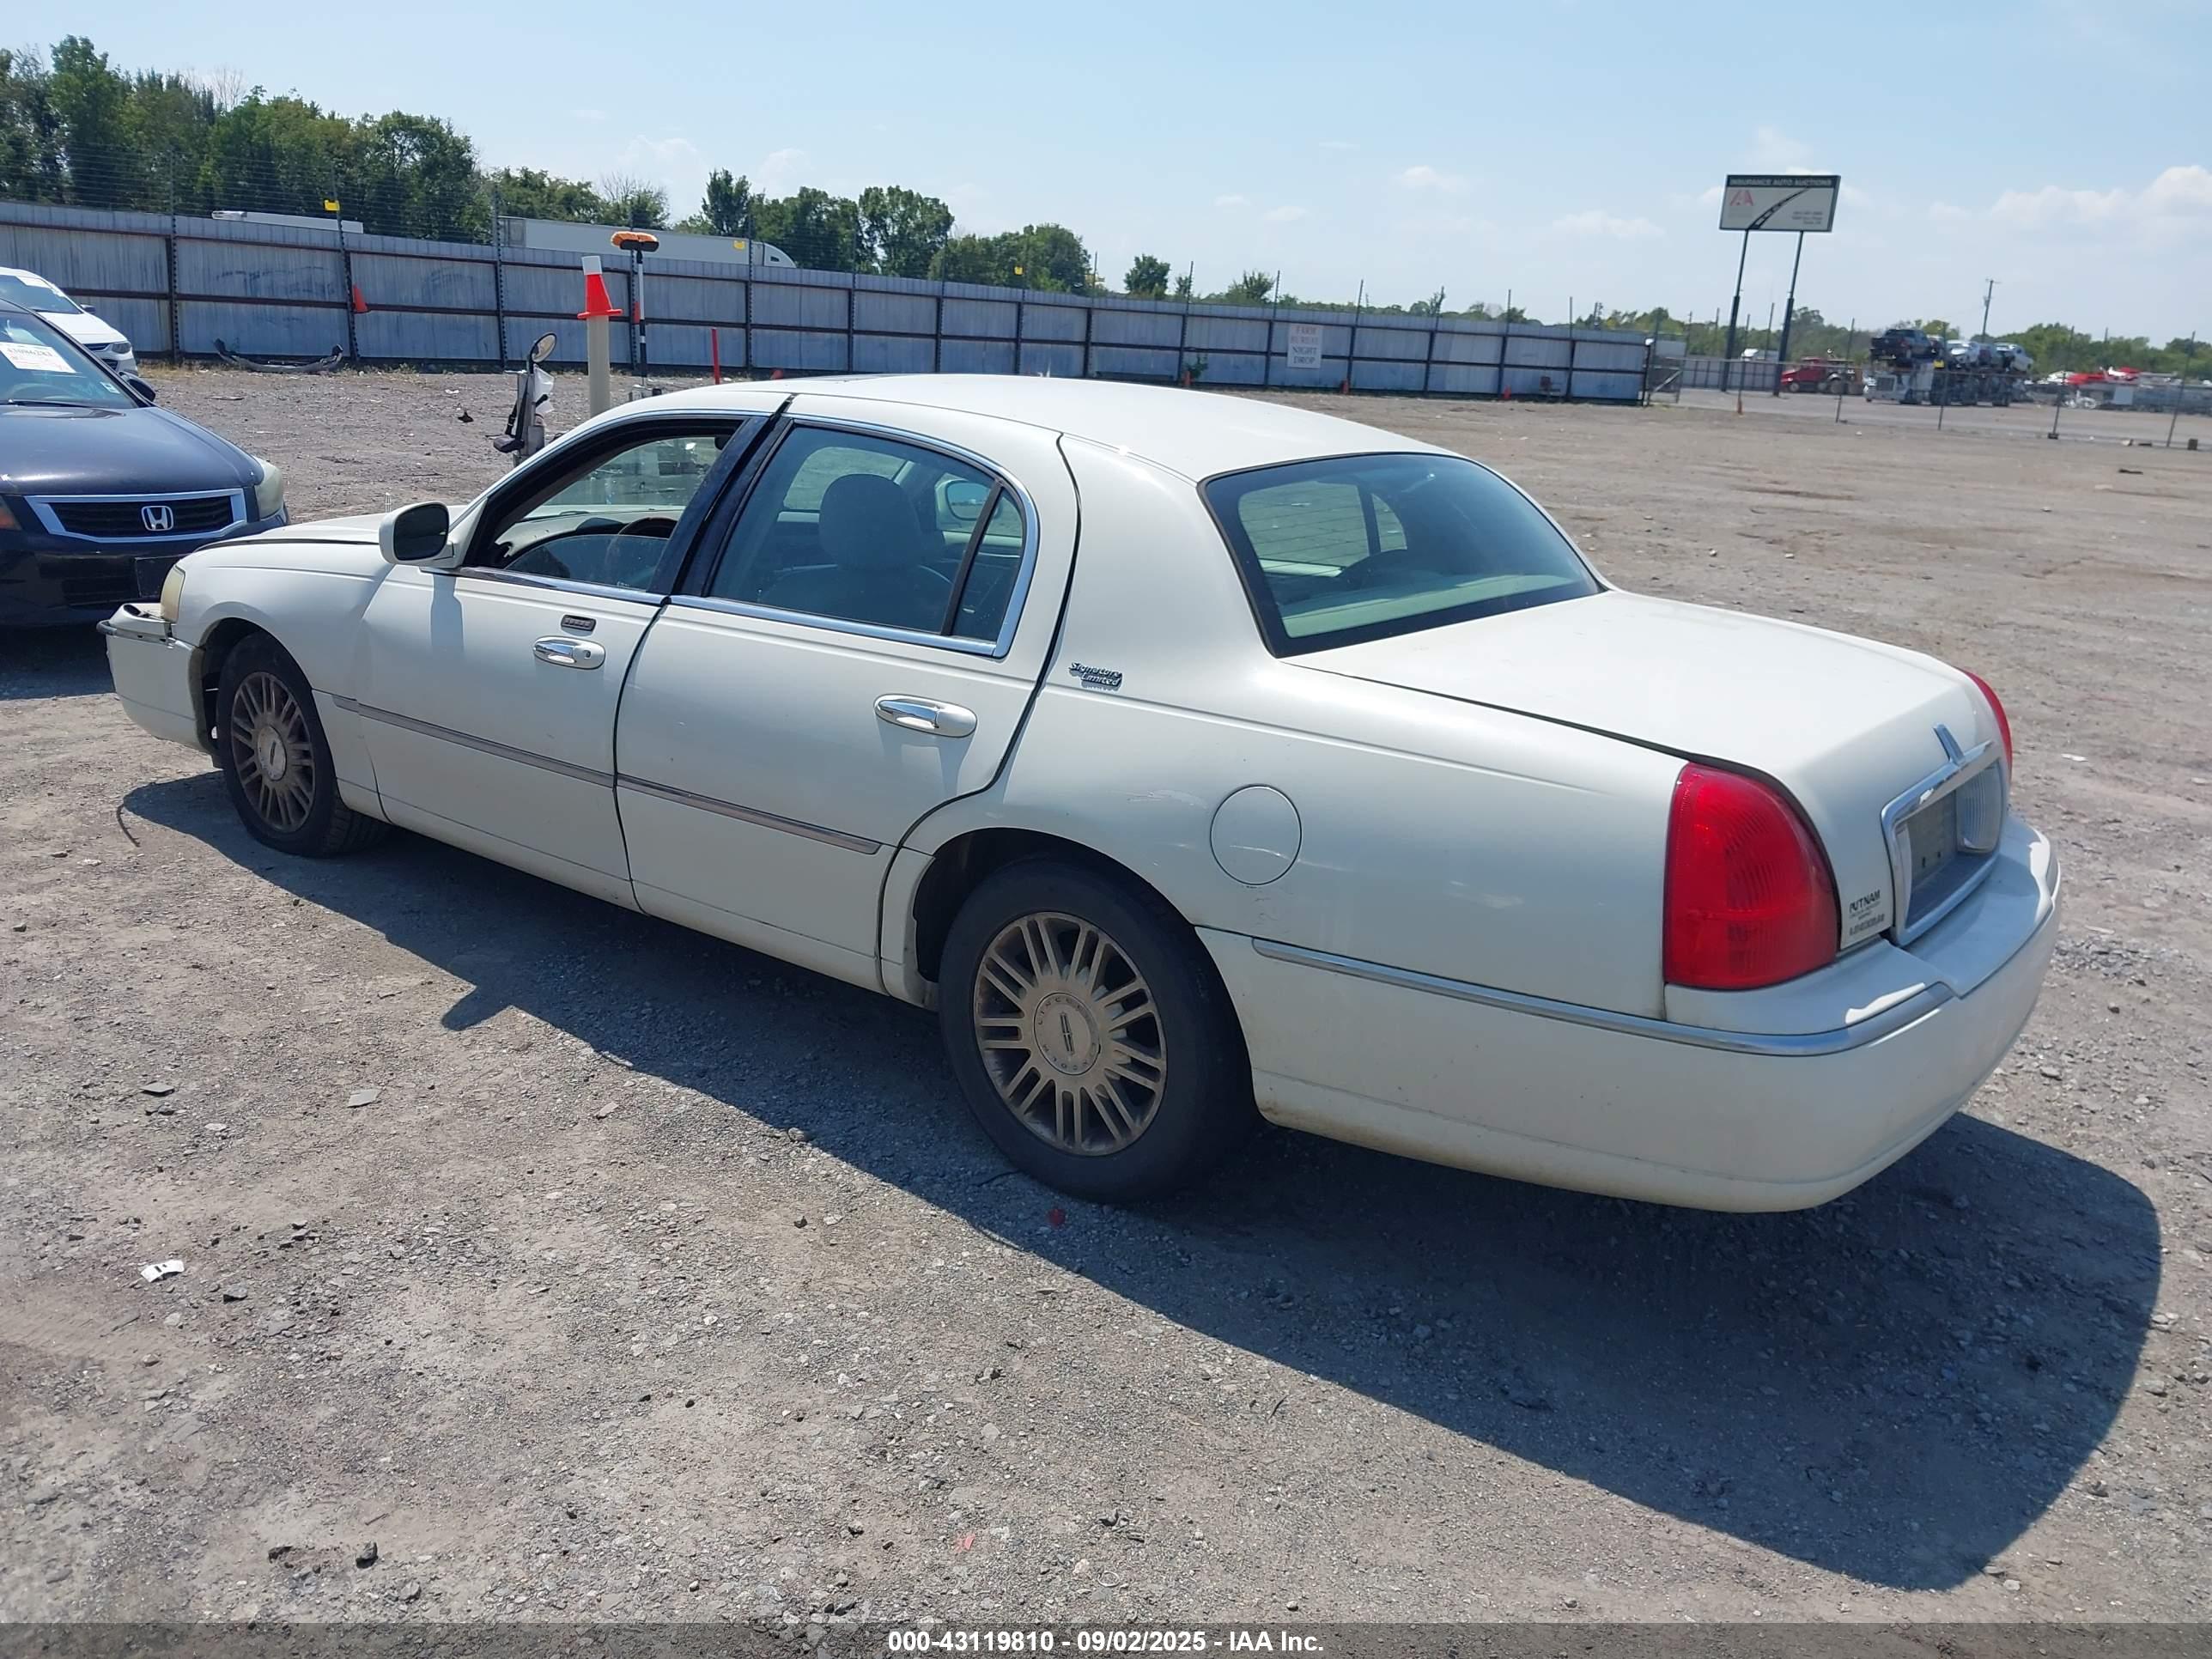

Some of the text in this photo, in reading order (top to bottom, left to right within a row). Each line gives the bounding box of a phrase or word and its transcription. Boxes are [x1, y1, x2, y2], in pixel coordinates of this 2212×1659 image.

[1773, 178, 1794, 186] AUTO
[1795, 178, 1832, 186] AUCTIONS
[1291, 345, 1318, 355] NIGHT
[1293, 356, 1316, 365] DROP
[1081, 672, 1121, 686] Limited
[1849, 890, 1881, 913] PUTNAM
